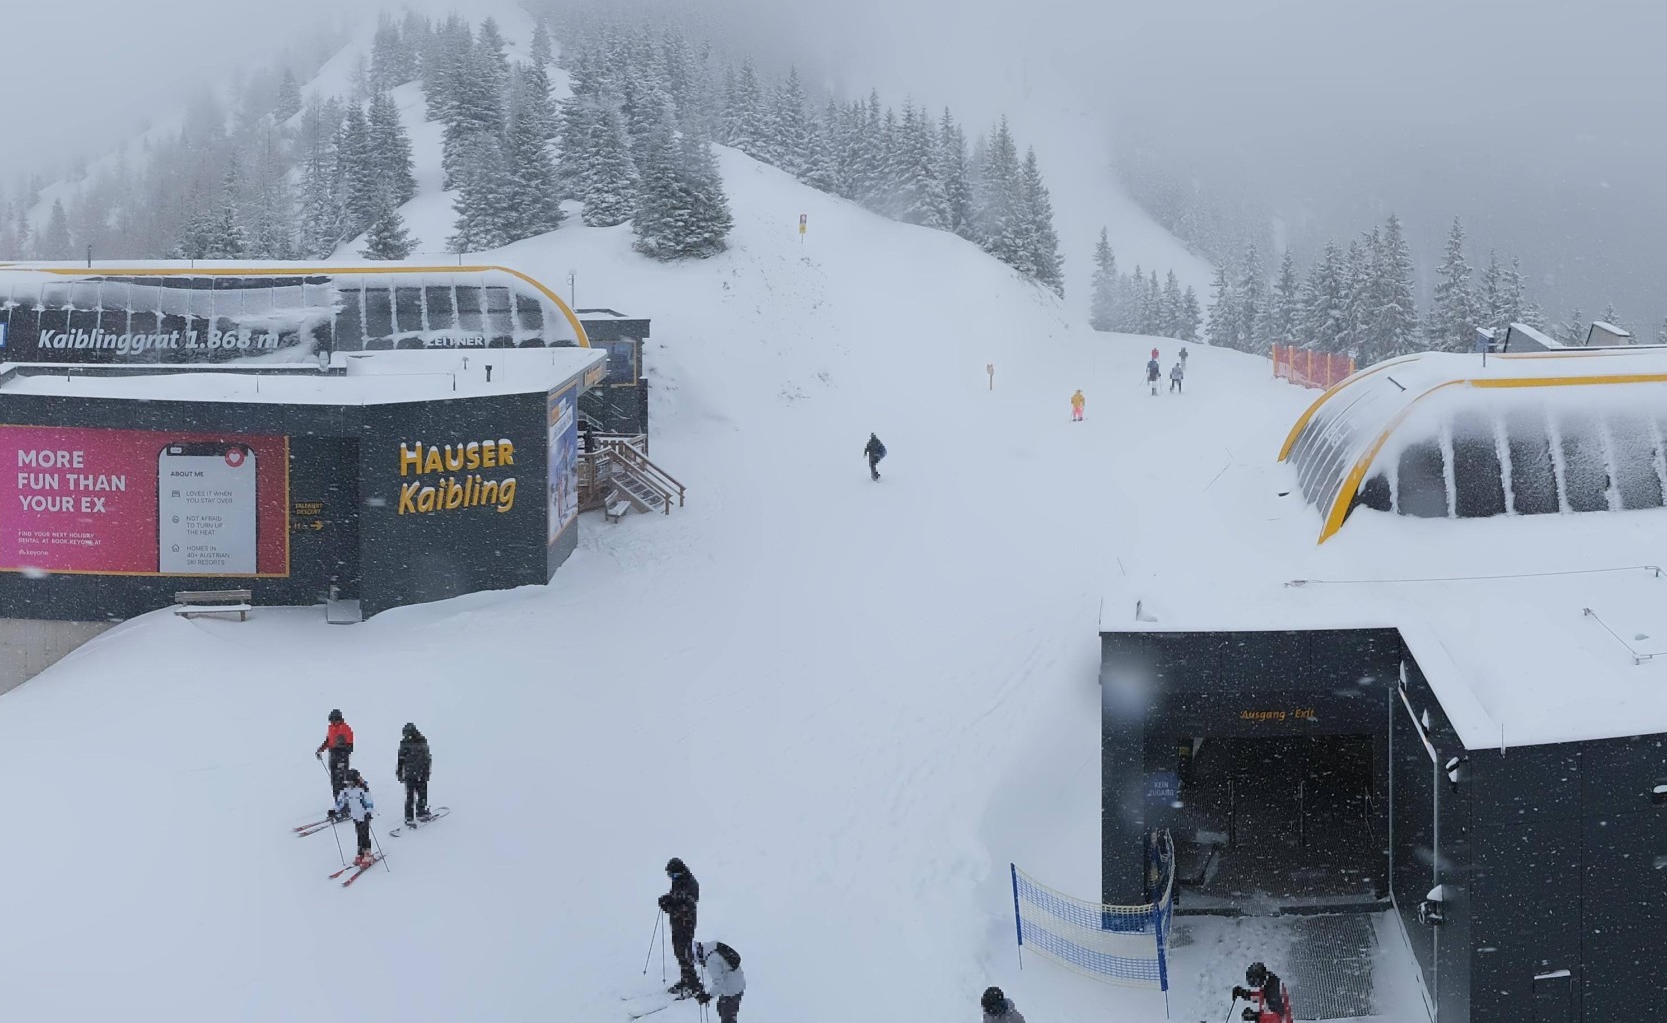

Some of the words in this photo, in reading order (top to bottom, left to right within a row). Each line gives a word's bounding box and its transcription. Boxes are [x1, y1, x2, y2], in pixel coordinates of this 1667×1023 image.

[38, 329, 180, 355] Kaiblinggrat
[186, 330, 251, 349] 1.868
[257, 334, 279, 348] m
[17, 449, 84, 469] MORE
[400, 439, 515, 476] HAUSER
[18, 473, 59, 490] FUN
[66, 474, 126, 492] THAN
[19, 496, 75, 512] YOUR
[81, 497, 106, 513] EX
[398, 475, 516, 515] Kaibling
[26, 549, 49, 557] keyone
[1240, 710, 1286, 721] Ausgang
[1294, 708, 1315, 717] Exit
